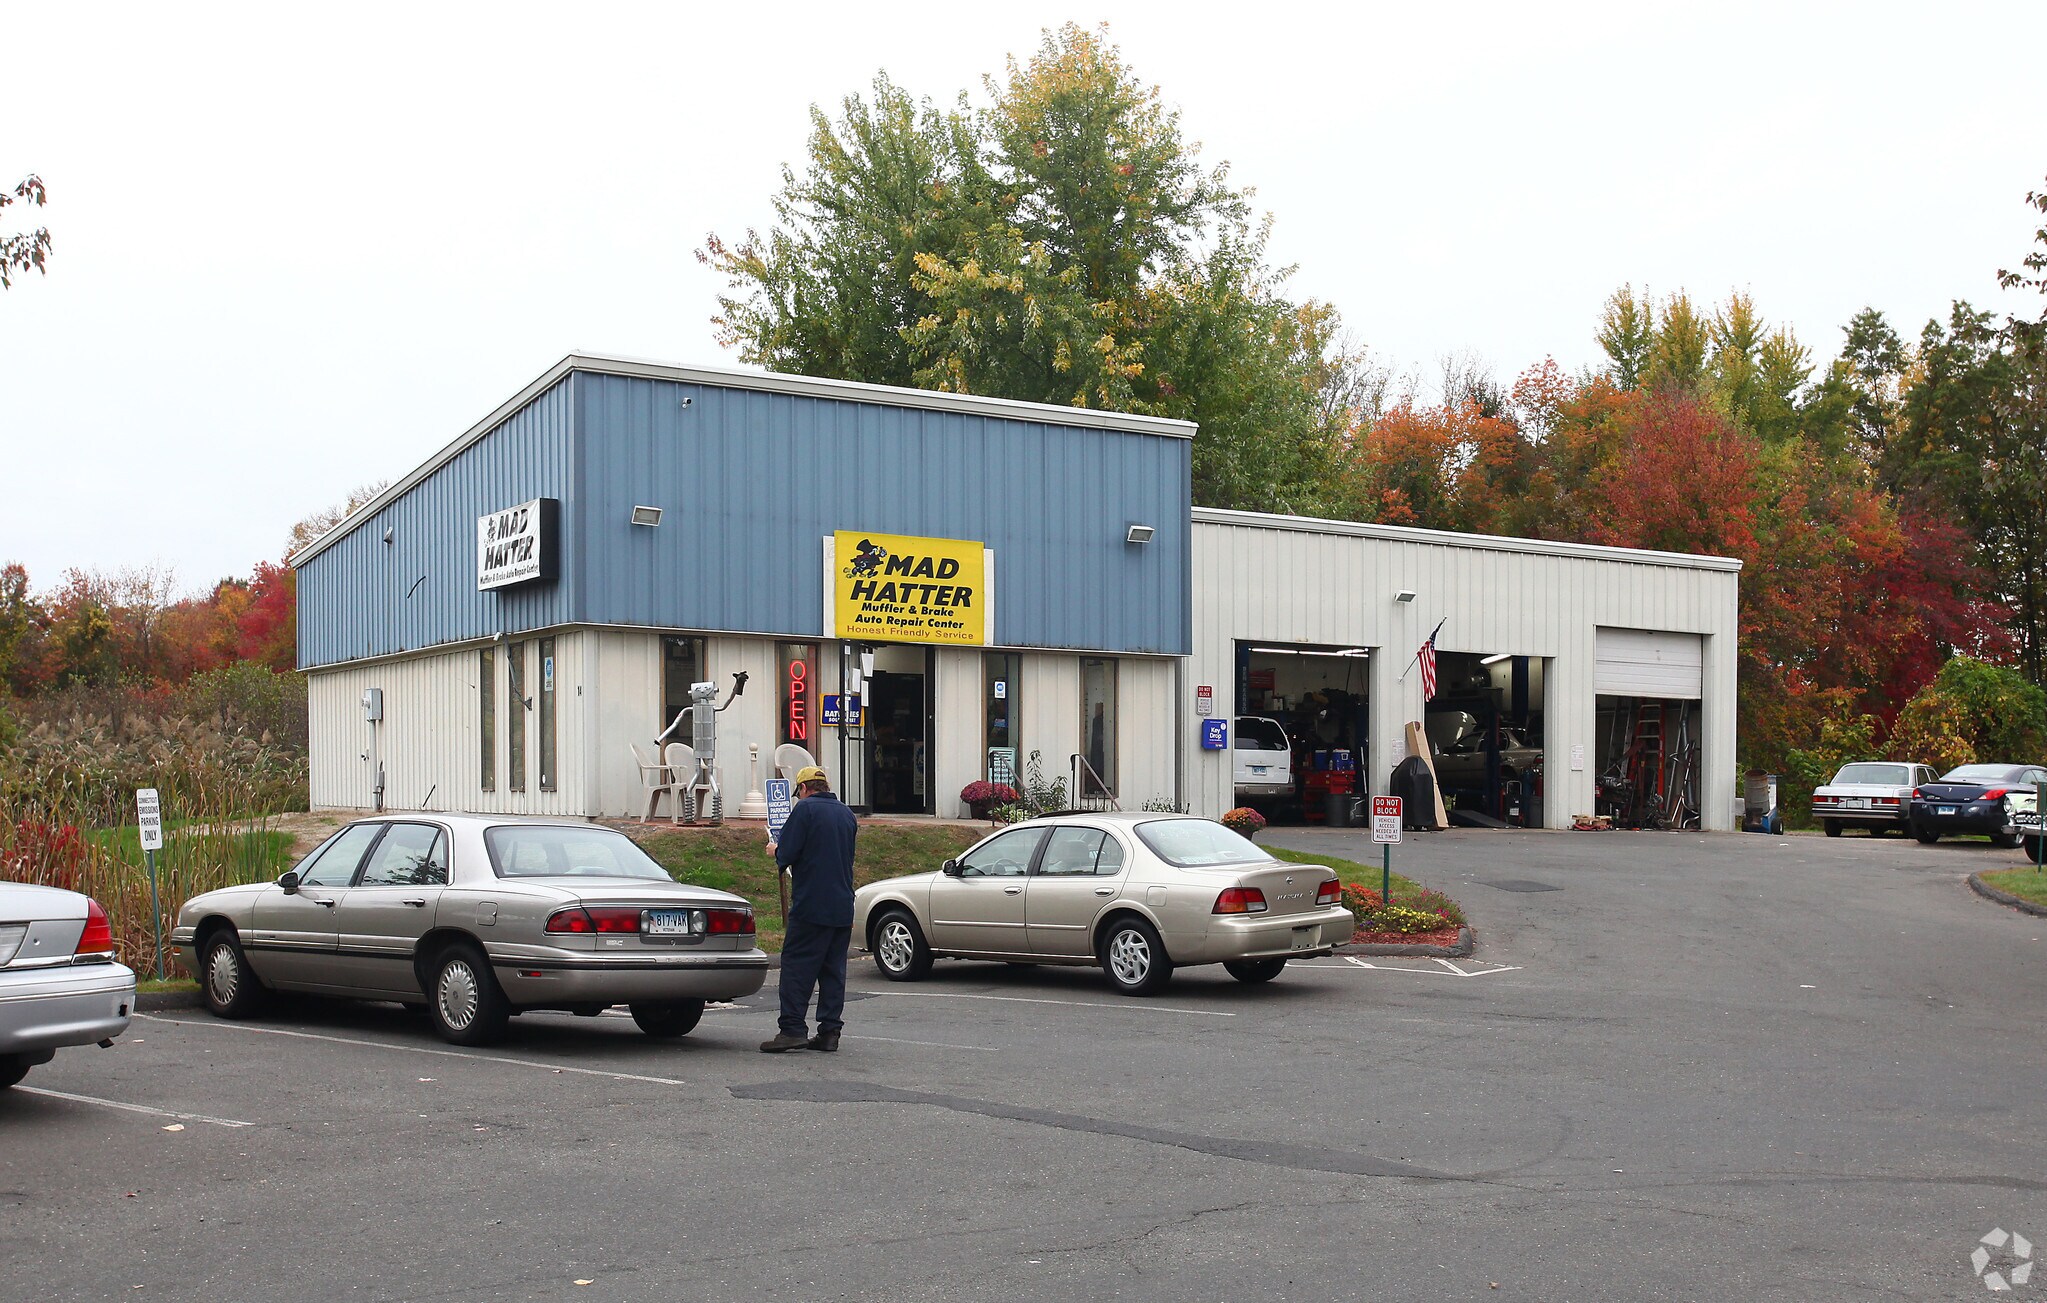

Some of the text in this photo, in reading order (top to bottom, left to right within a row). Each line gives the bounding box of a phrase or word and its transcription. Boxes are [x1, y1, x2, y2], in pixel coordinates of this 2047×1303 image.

[497, 508, 528, 540] MAD
[484, 535, 534, 570] HATTER
[884, 554, 960, 579] MAD
[850, 580, 972, 607] HATTER
[862, 602, 954, 616] Muffler & Brake
[855, 614, 964, 629] Auto Repair Center
[847, 625, 974, 640] Honest Friendly Service
[790, 660, 806, 740] OPEN
[139, 806, 158, 814] EMISSIONS
[141, 816, 158, 826] PARKING
[144, 830, 157, 841] ONLY
